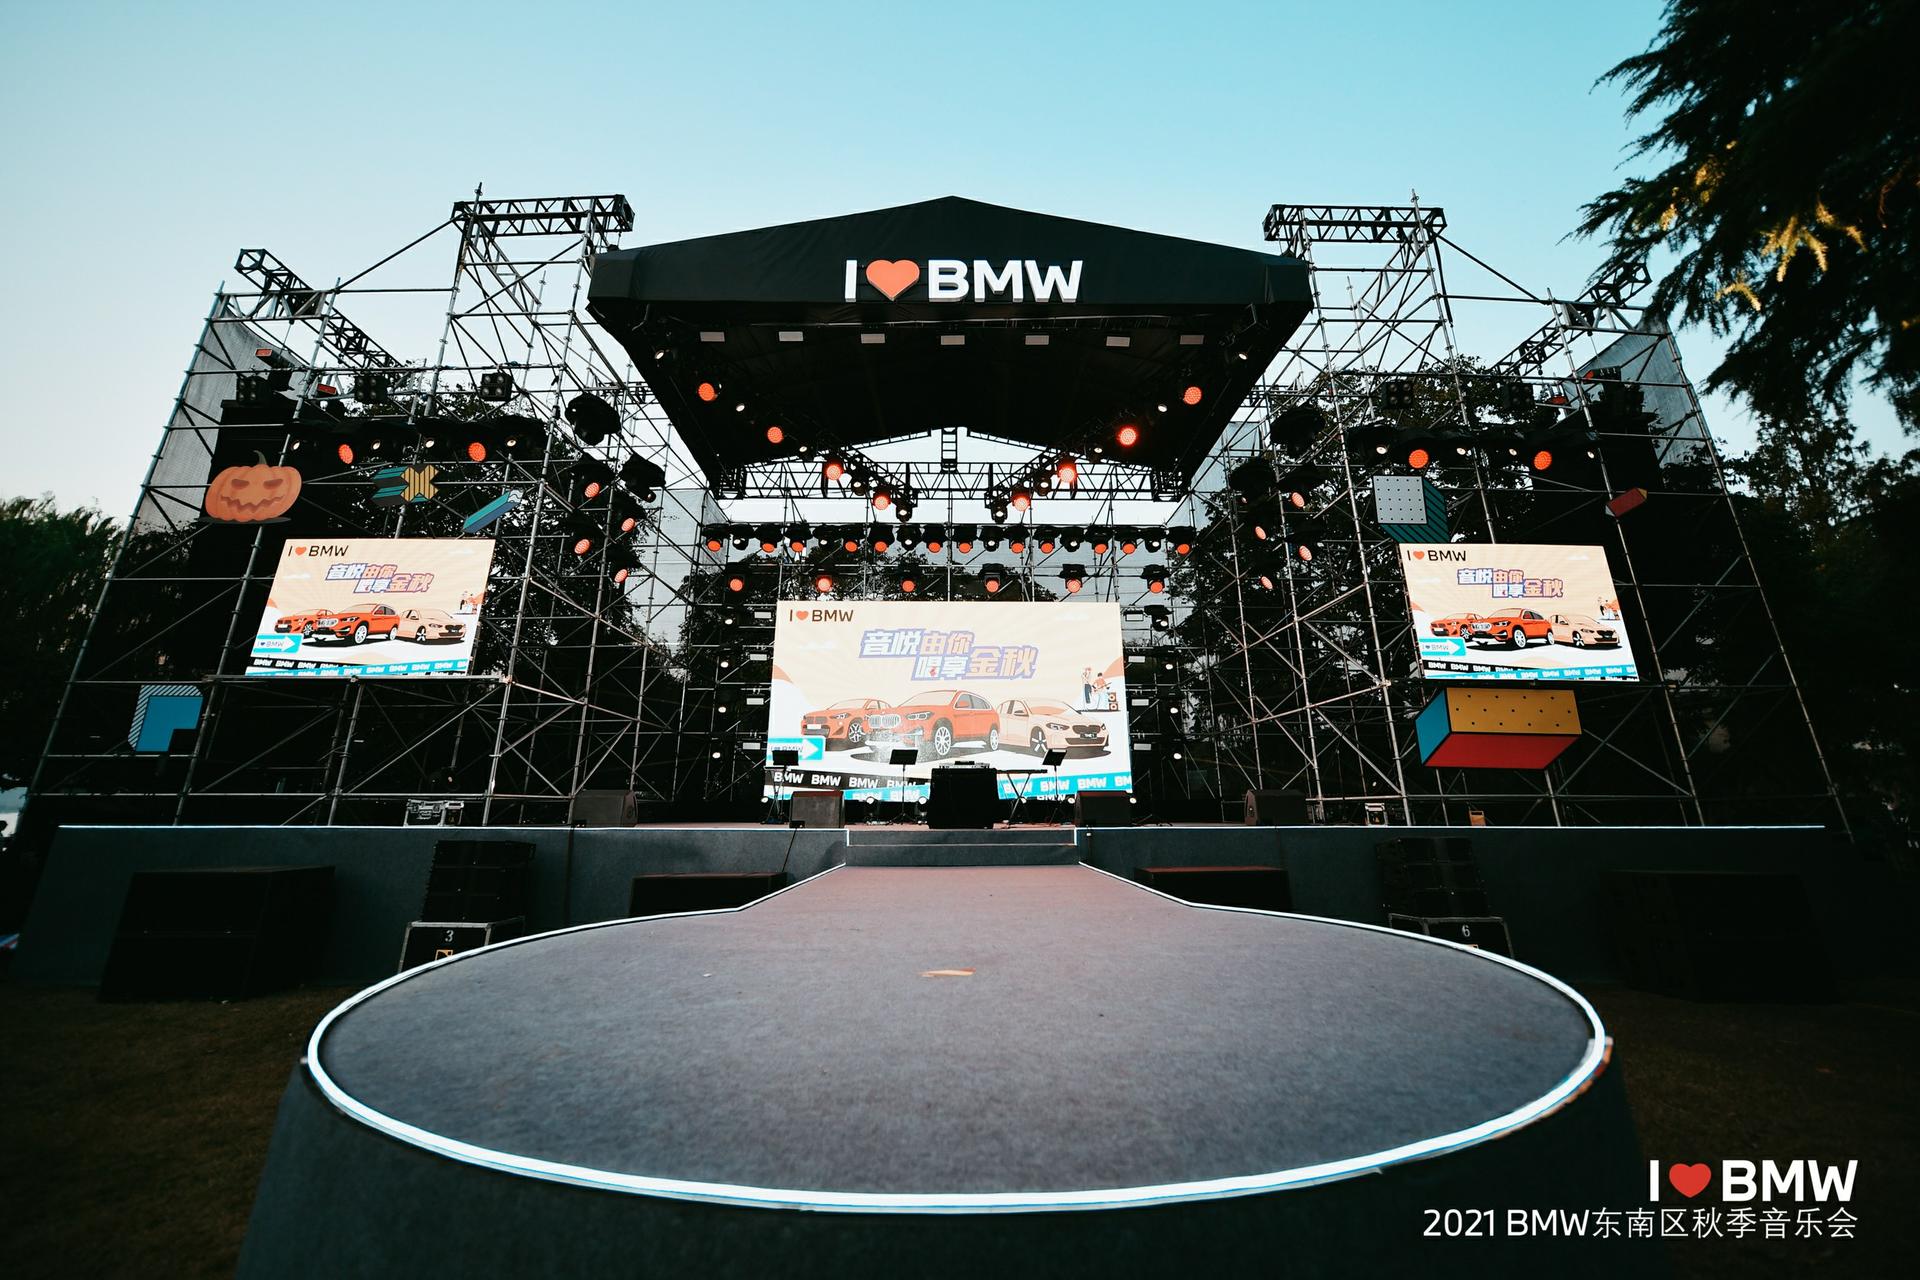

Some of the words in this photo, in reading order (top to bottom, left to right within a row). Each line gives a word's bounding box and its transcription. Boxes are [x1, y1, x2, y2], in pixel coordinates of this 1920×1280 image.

[844, 259, 857, 302] I
[928, 259, 1083, 302] BMW
[288, 545, 293, 556] I
[308, 545, 349, 556] BMW
[1407, 550, 1411, 561] I
[1428, 550, 1466, 561] BMW
[790, 609, 793, 622] I
[812, 609, 854, 622] BMW
[861, 630, 973, 657] 音悦由你
[774, 772, 804, 784] BMW
[811, 774, 841, 786] BMW
[848, 777, 879, 788] BMW
[1040, 780, 1070, 791] BMW
[1077, 776, 1107, 788] BMW
[445, 930, 454, 942] 3
[1462, 924, 1470, 937] 6
